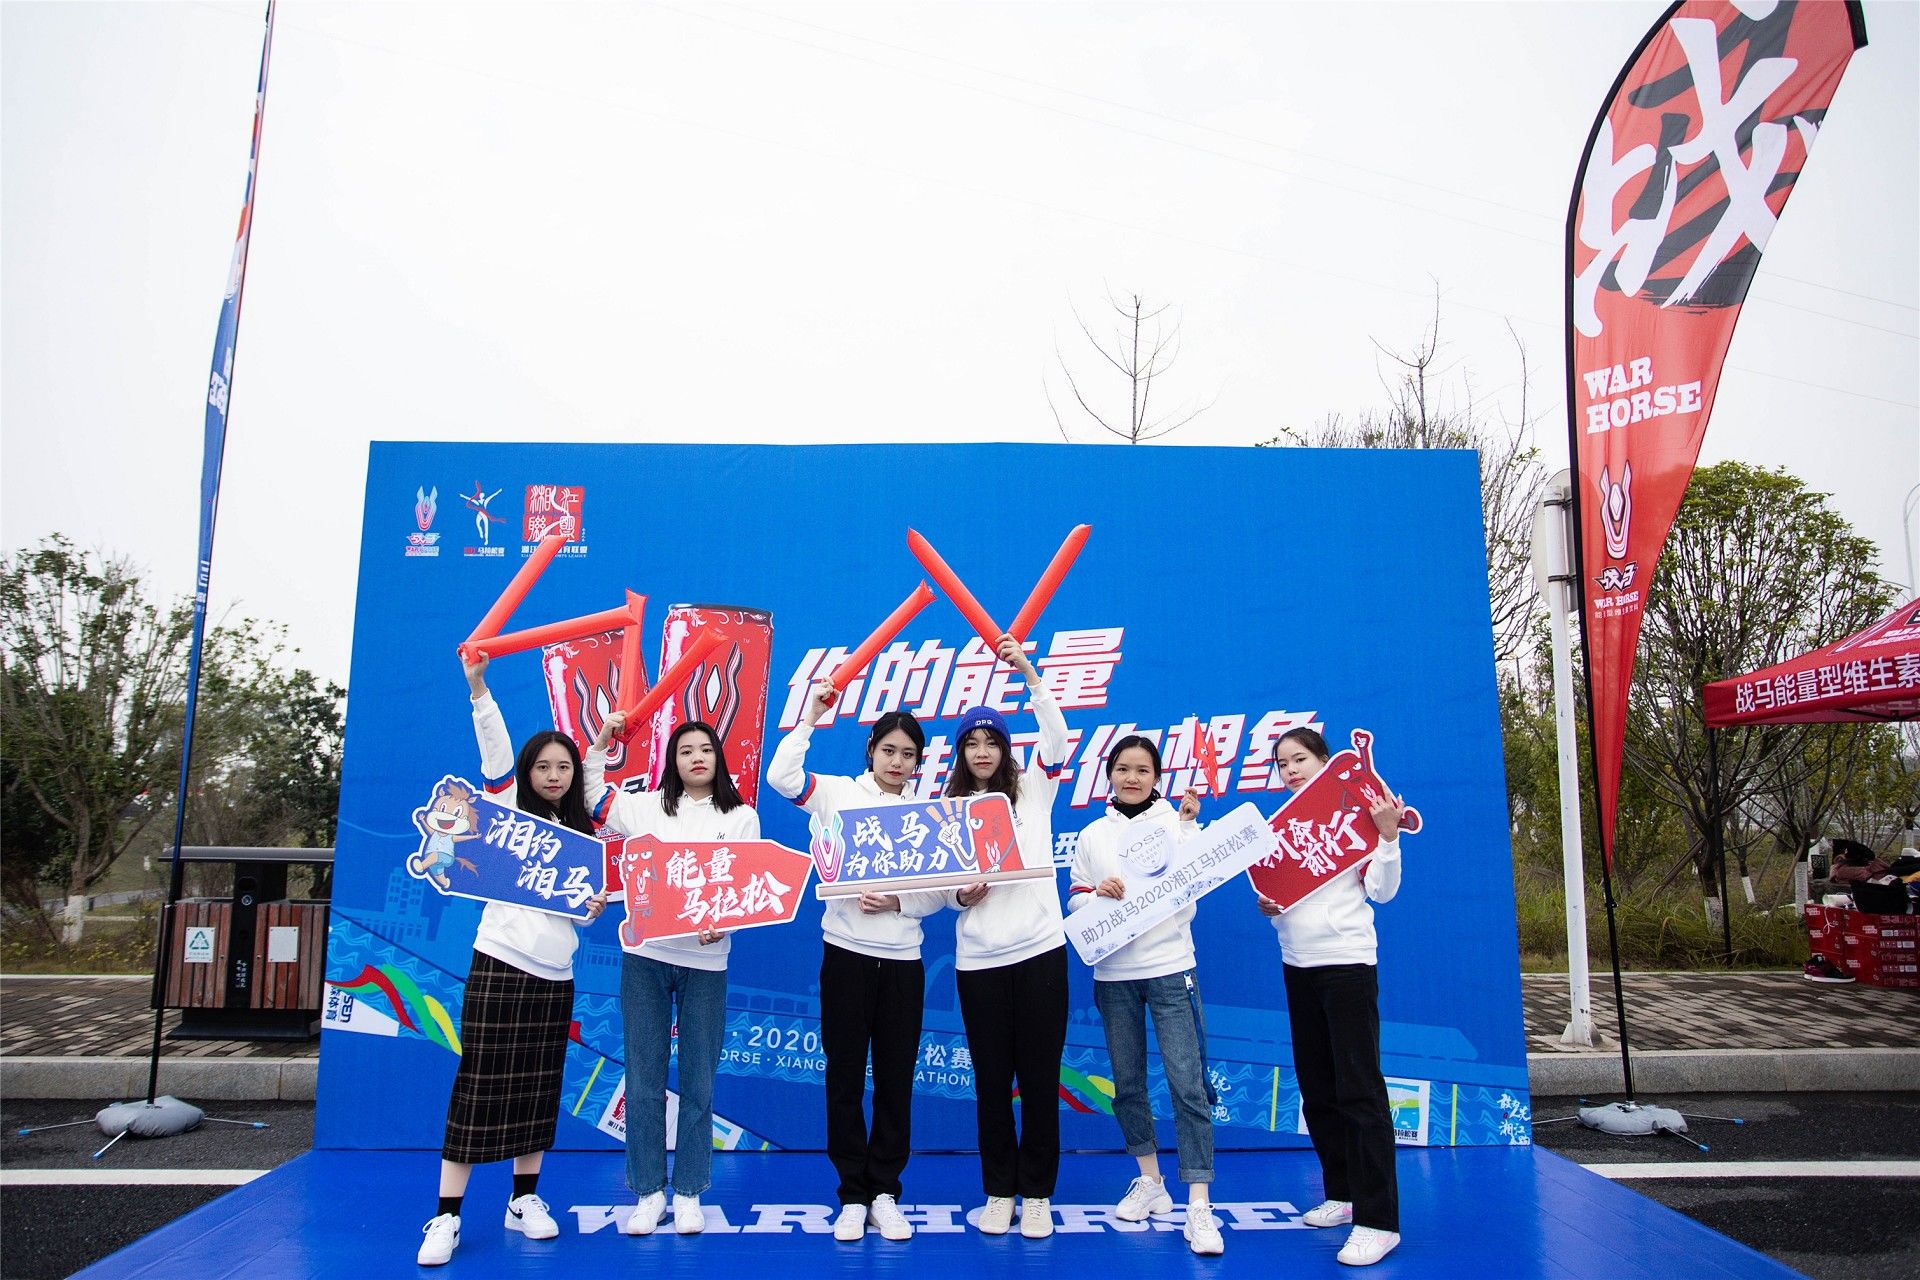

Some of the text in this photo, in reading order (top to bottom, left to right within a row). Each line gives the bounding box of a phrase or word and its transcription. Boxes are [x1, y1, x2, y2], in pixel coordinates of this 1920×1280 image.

[1583, 356, 1653, 400] WAR
[1586, 380, 1702, 434] HORSE
[778, 627, 1124, 730] 你的能量
[1735, 652, 1920, 714] 战马能量型维生素
[485, 811, 563, 863] 湘约
[852, 810, 930, 849] 战马
[1119, 826, 1166, 858] VOSS
[516, 860, 595, 908] 湘马
[665, 847, 736, 889] 能量
[845, 846, 949, 879] 为你助力
[1081, 824, 1259, 945] 助力战马2020湘江马拉松赛
[677, 871, 792, 924] 马拉松
[748, 1026, 818, 1053] 2020
[720, 1049, 761, 1064] ORSE
[914, 1070, 970, 1086] ATHON
